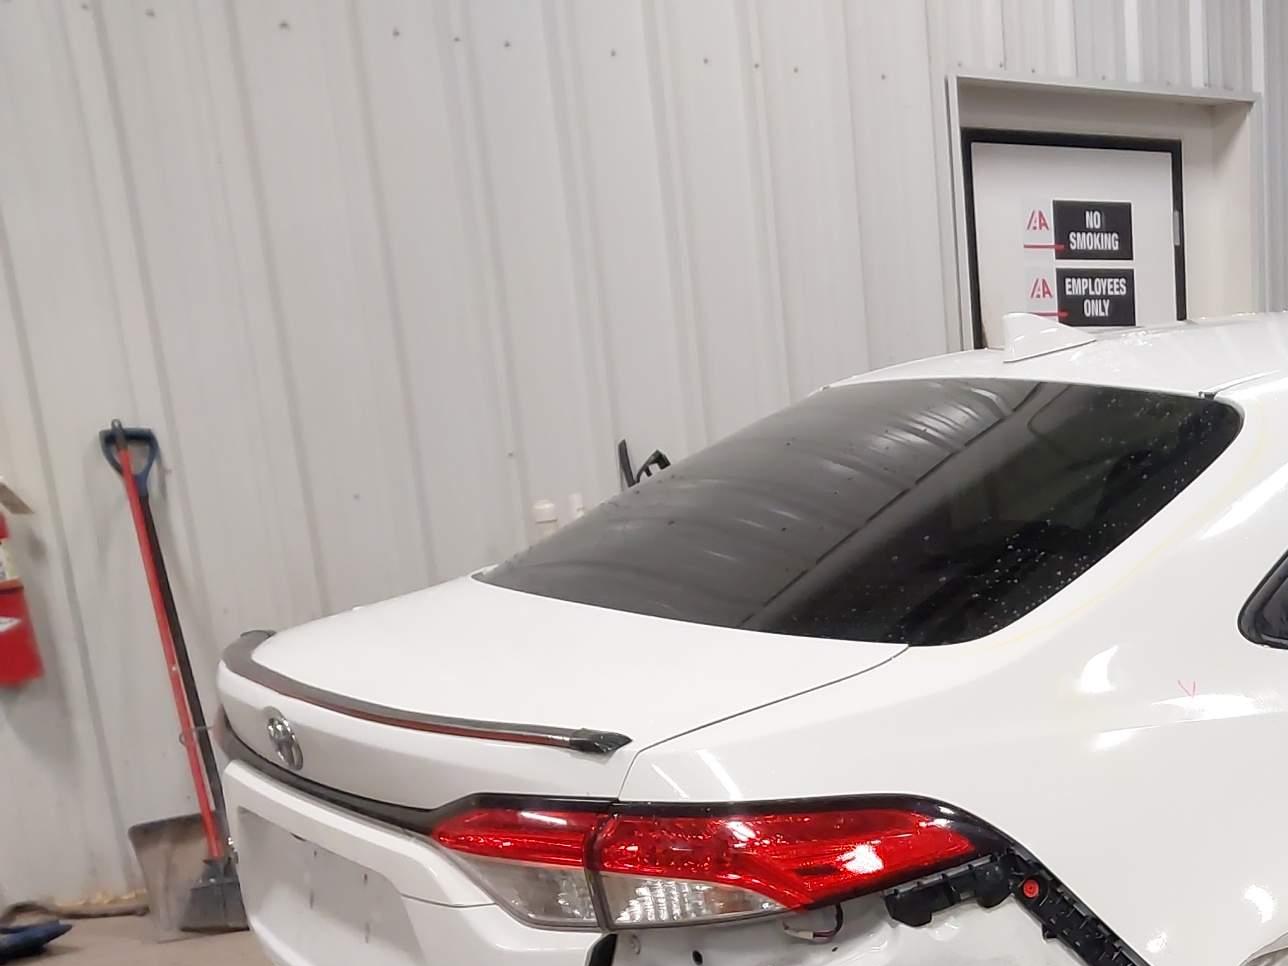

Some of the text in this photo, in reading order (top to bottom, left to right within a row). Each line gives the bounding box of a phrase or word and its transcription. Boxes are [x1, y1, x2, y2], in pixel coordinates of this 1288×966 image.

[1085, 211, 1101, 229] NO
[1069, 232, 1119, 250] SMOKING
[1065, 278, 1127, 296] EMPLOYEES
[1083, 299, 1110, 317] ONLY
